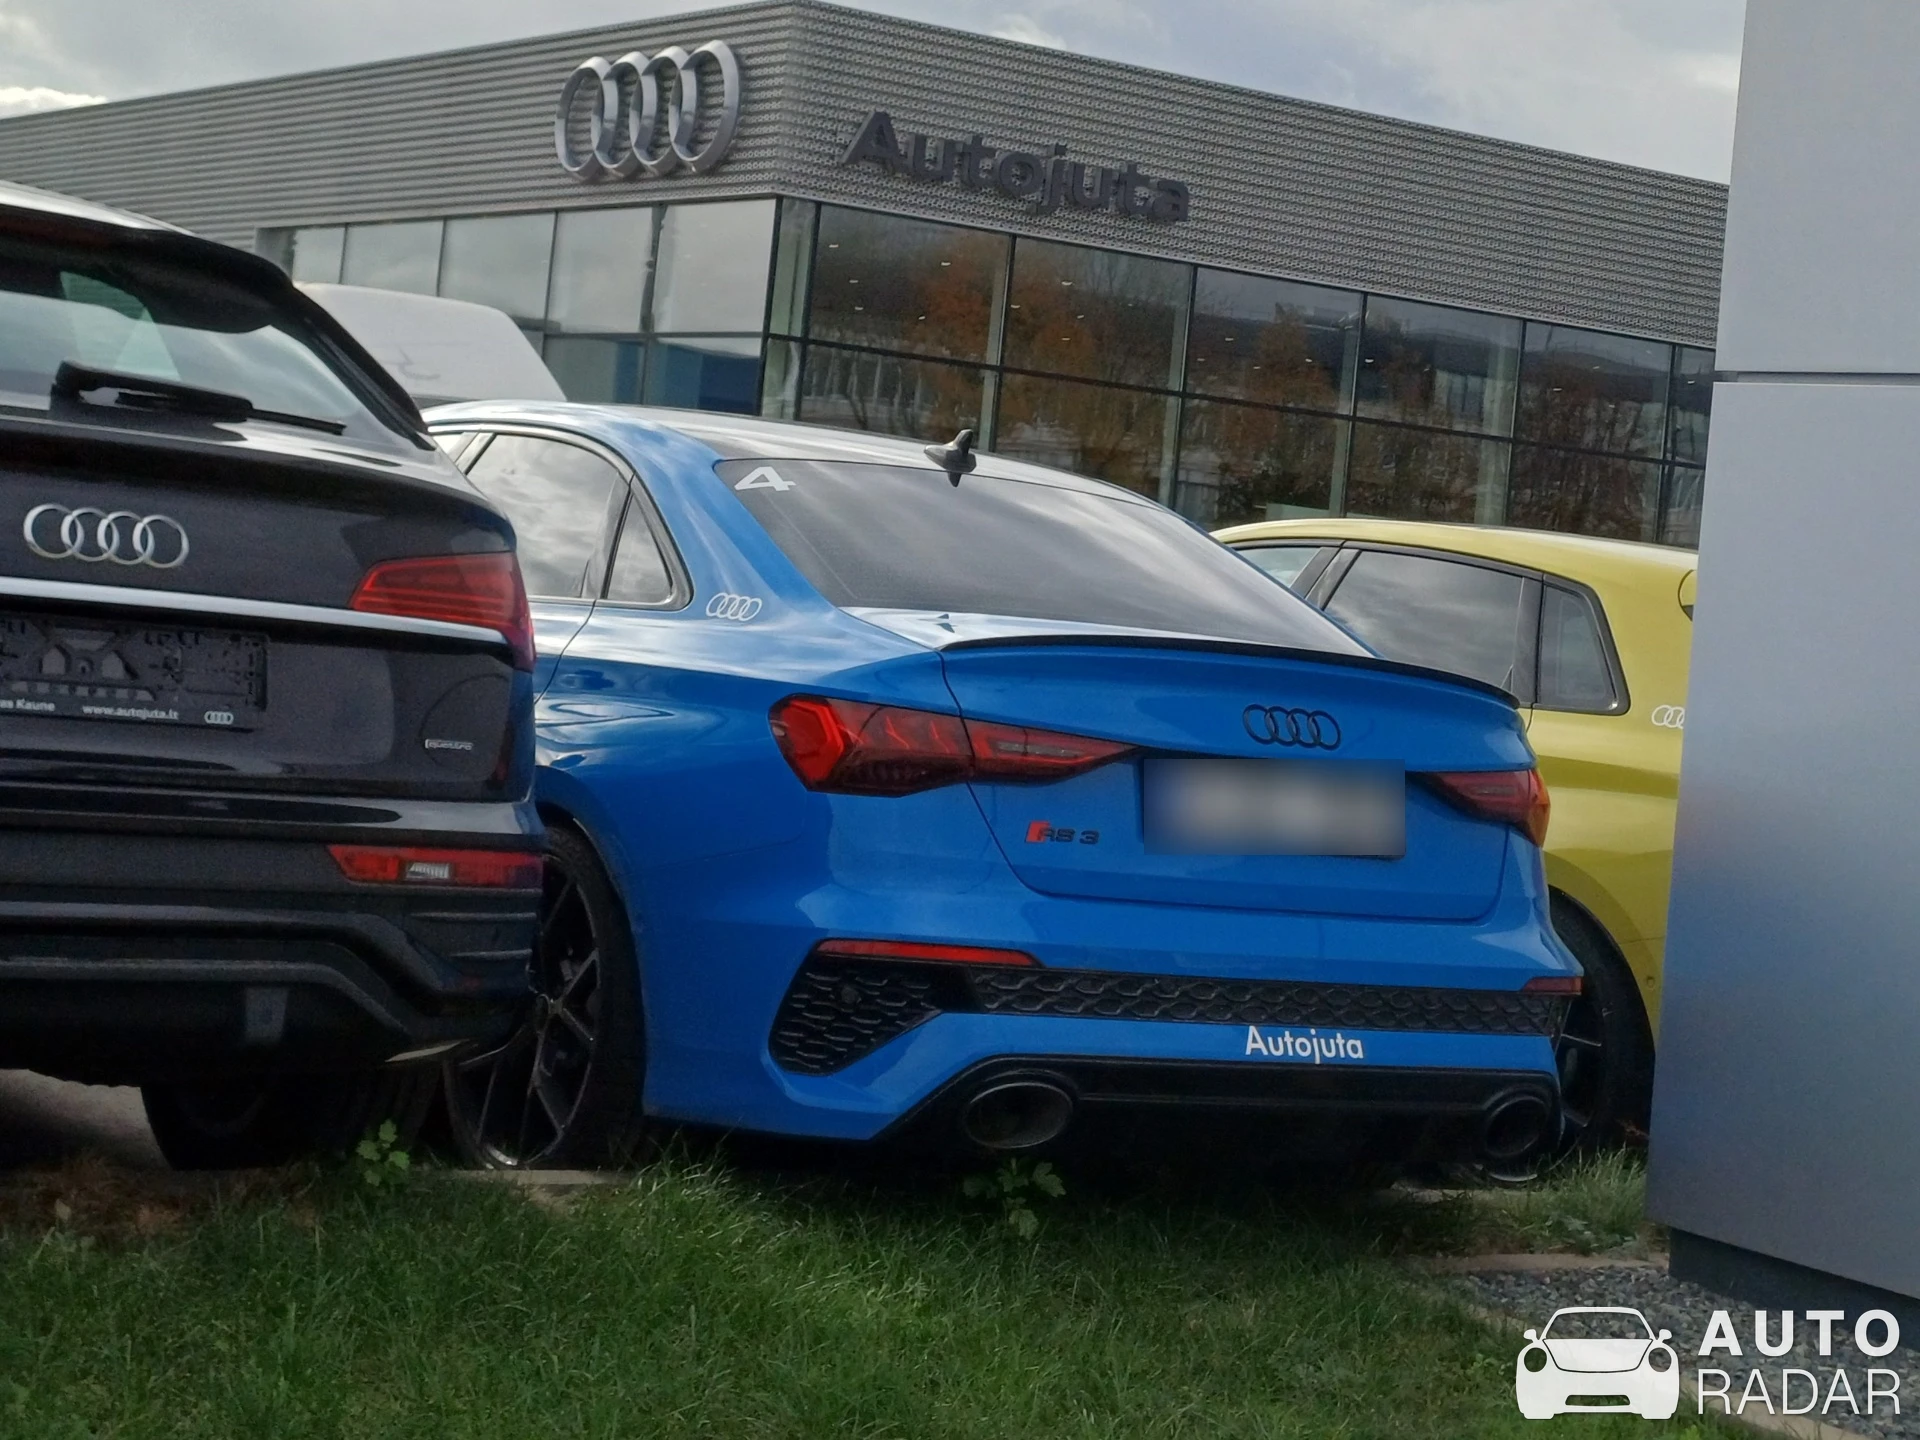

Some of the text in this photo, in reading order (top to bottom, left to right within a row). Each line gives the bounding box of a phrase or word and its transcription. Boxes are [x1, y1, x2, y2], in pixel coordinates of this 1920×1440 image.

[841, 109, 1191, 222] Autojuta
[82, 705, 179, 720] www.autojuta.lt
[1025, 820, 1100, 845] RS 3
[1245, 1025, 1364, 1064] Autojuta
